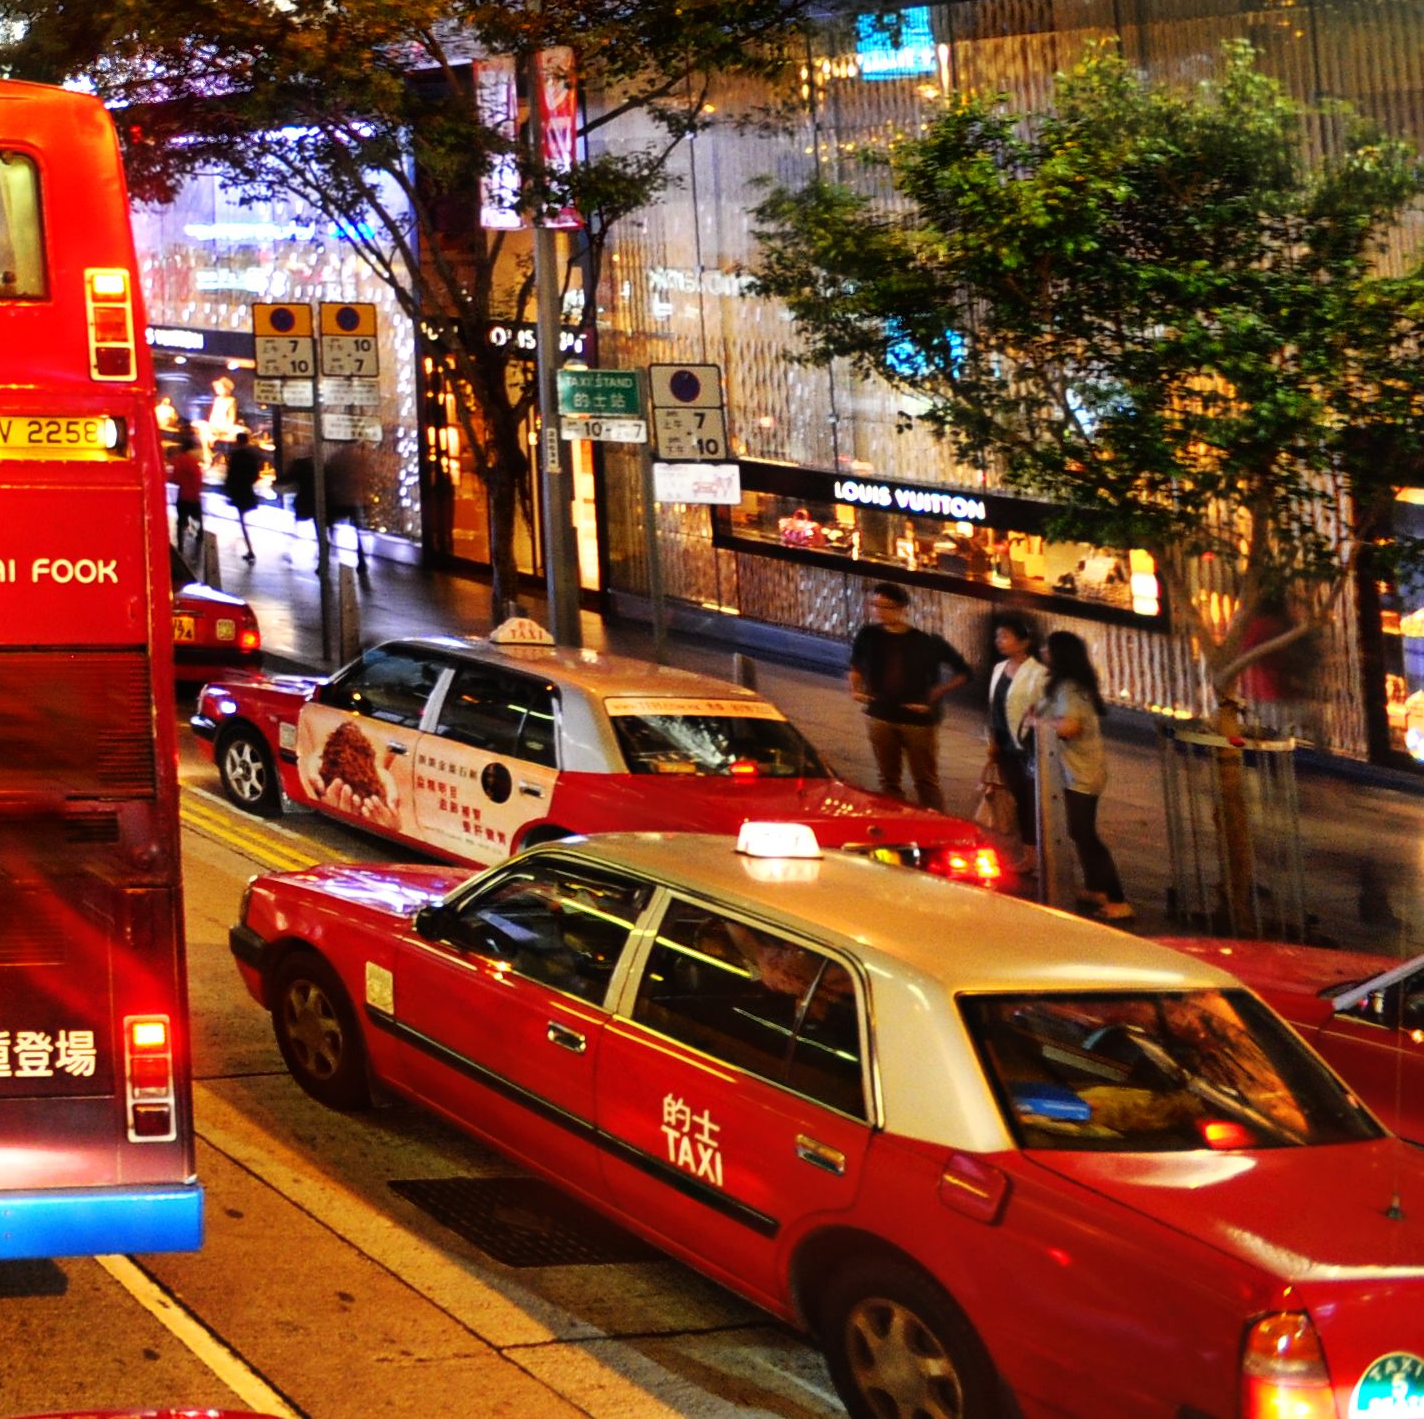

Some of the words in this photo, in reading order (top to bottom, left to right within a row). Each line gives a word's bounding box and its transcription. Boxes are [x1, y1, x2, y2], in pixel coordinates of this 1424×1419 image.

[289, 340, 298, 353] 7
[354, 339, 371, 352] 10
[291, 360, 308, 373] 10
[354, 359, 364, 372] 7
[584, 421, 603, 437] 10
[694, 412, 705, 429] 7
[28, 420, 98, 444] 2258
[696, 438, 718, 455] 10
[834, 481, 892, 506] LOUIS
[895, 488, 986, 520] VUITTON
[31, 558, 118, 584] FOOK
[663, 1092, 720, 1148] 的士
[661, 1125, 723, 1186] TAXI
